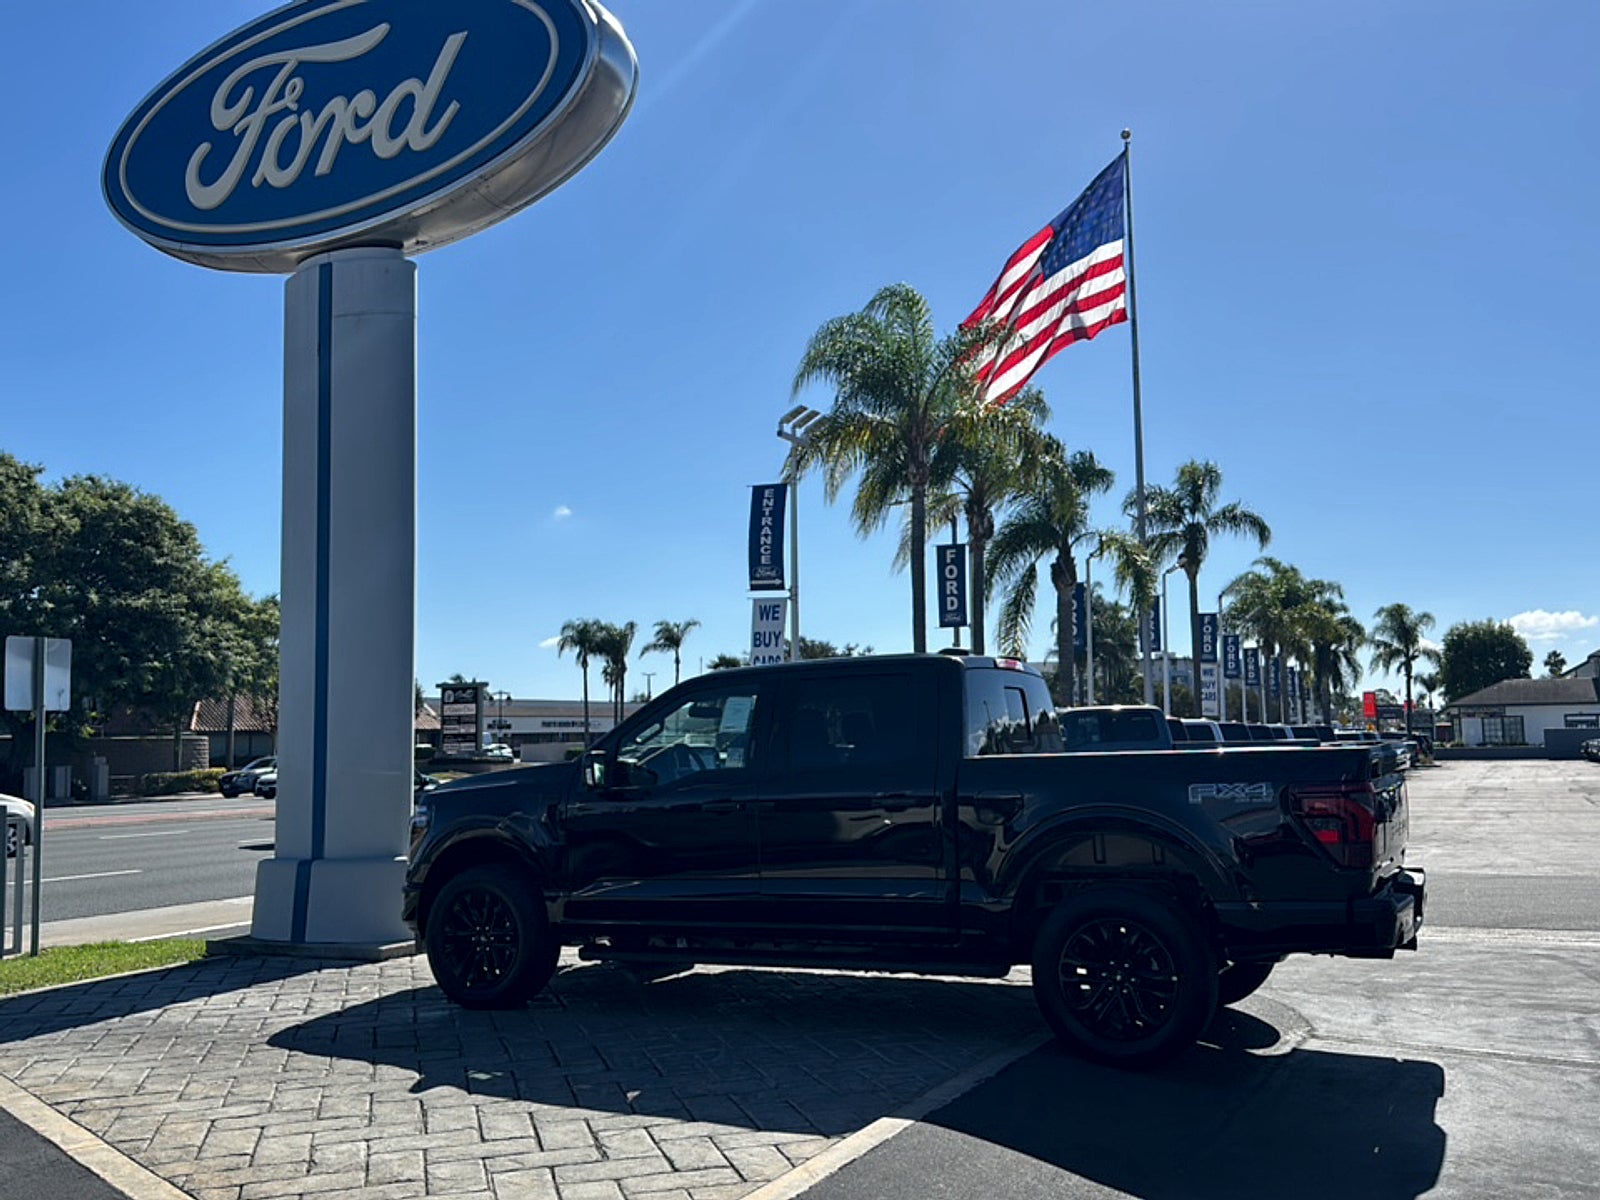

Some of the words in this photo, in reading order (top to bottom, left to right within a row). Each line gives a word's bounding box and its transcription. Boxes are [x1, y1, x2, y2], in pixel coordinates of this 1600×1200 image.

[185, 23, 468, 209] Ford
[760, 488, 775, 565] ENTRANCE
[945, 549, 958, 611] FORD
[759, 605, 781, 621] WE
[753, 631, 782, 648] BUY
[1203, 615, 1212, 653] FORD
[1227, 637, 1236, 669] FORD
[1188, 782, 1274, 804] FX4
